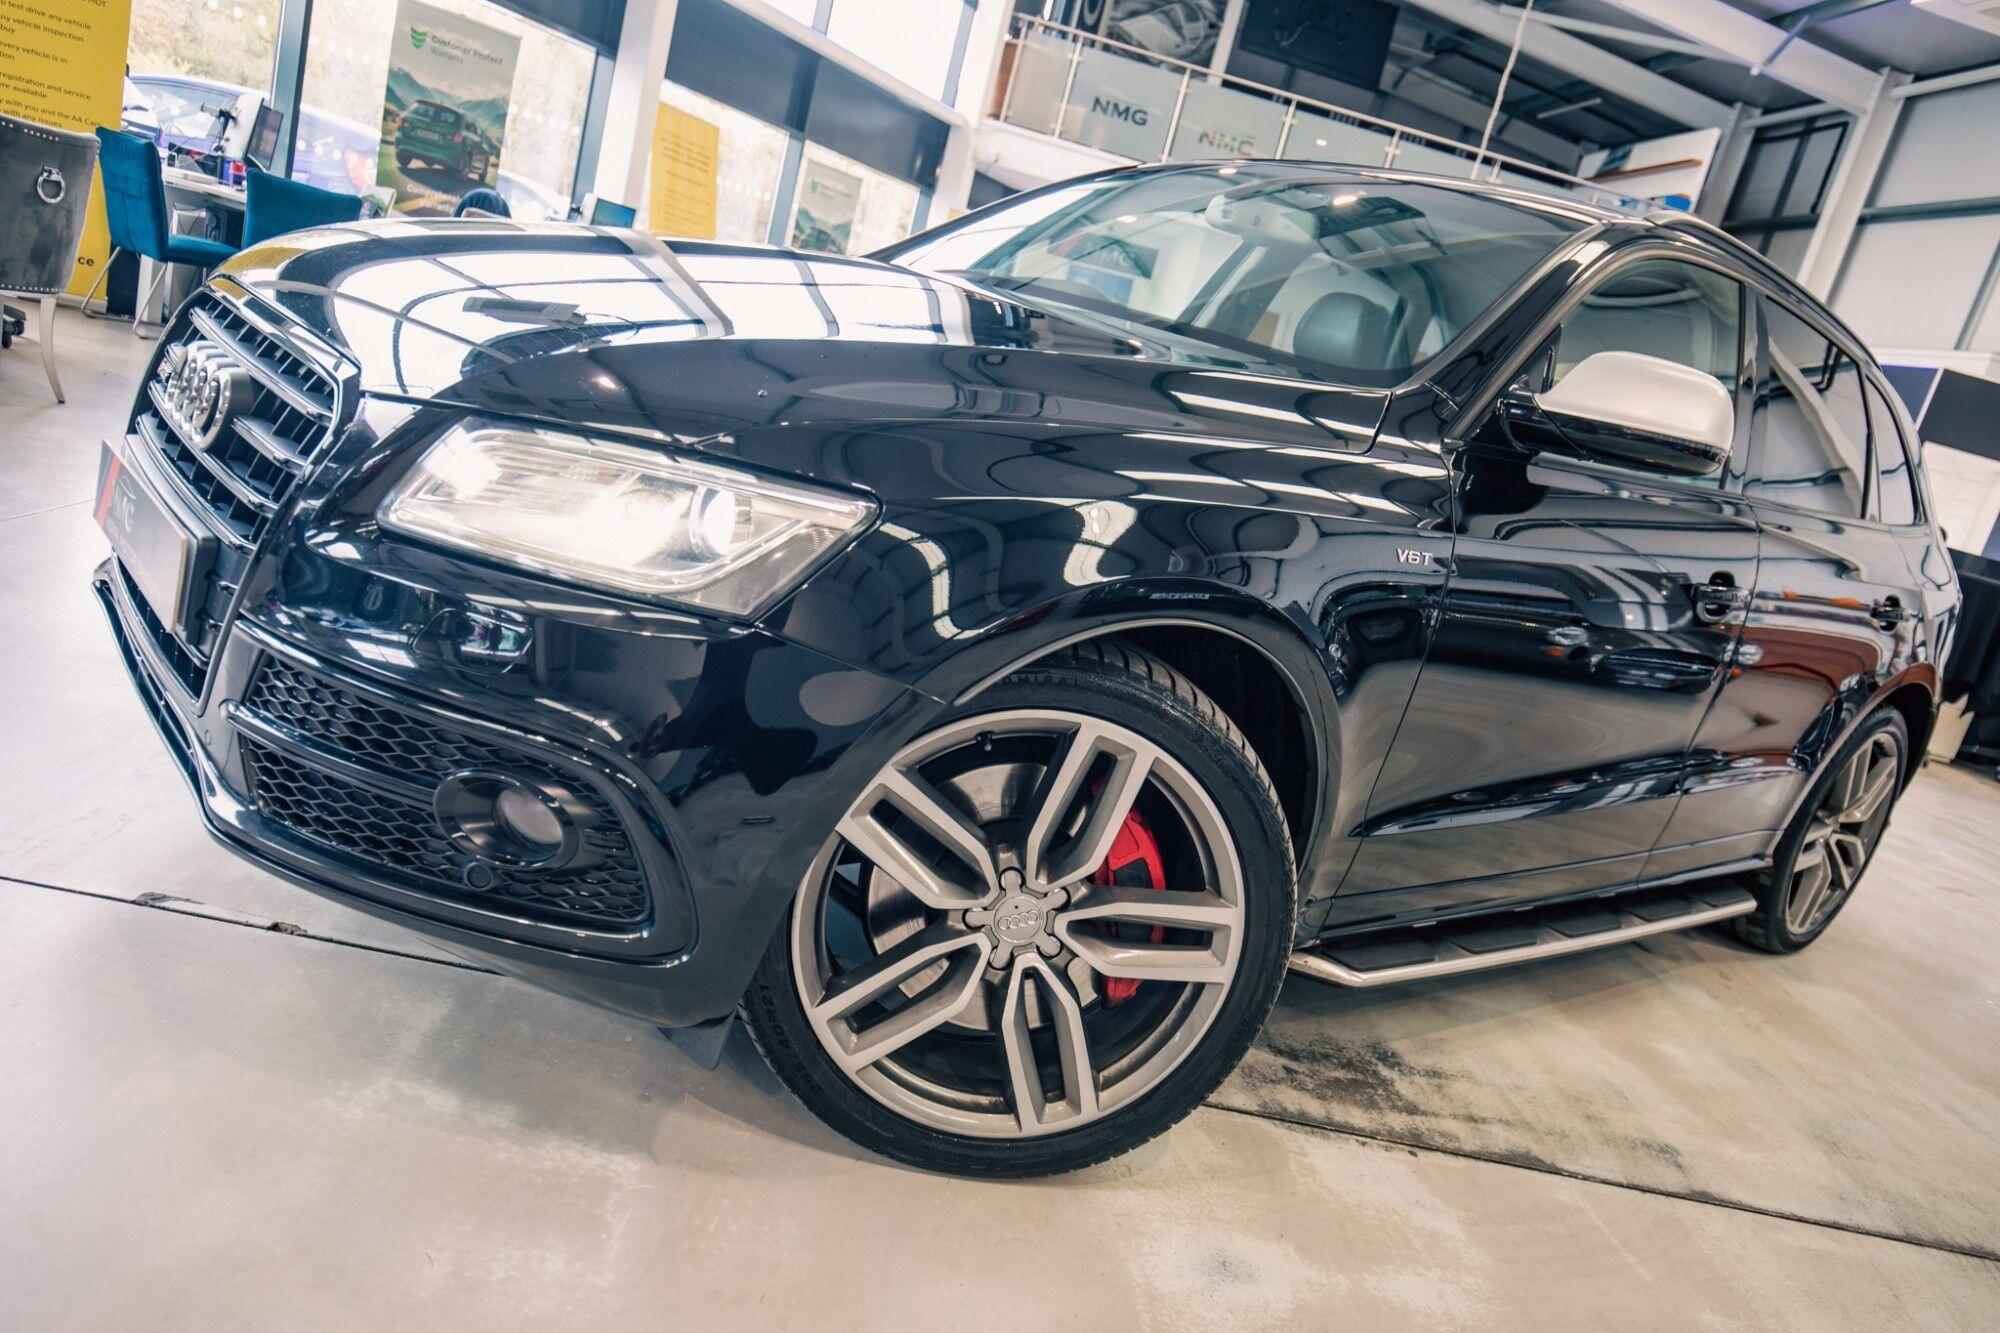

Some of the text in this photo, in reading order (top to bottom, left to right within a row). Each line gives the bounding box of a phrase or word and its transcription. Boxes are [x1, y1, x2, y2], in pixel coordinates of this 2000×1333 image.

[8, 1, 24, 11] test
[25, 5, 46, 17] drive
[48, 12, 62, 23] any
[63, 17, 92, 30] vehicle
[0, 24, 16, 35] buy
[13, 17, 41, 30] vehicle
[43, 25, 84, 42] inspection
[22, 46, 51, 59] vehicle
[52, 54, 59, 62] is
[60, 56, 69, 64] in
[0, 71, 92, 101] registration and service
[12, 85, 48, 99] available
[3, 108, 63, 128] with any issues
[5, 98, 23, 108] with
[25, 104, 39, 113] you
[41, 107, 56, 116] and
[57, 111, 70, 119] the
[71, 114, 83, 124] AA
[1091, 96, 1149, 127] NMG
[77, 256, 95, 267] ce
[1396, 548, 1434, 566] V6T
